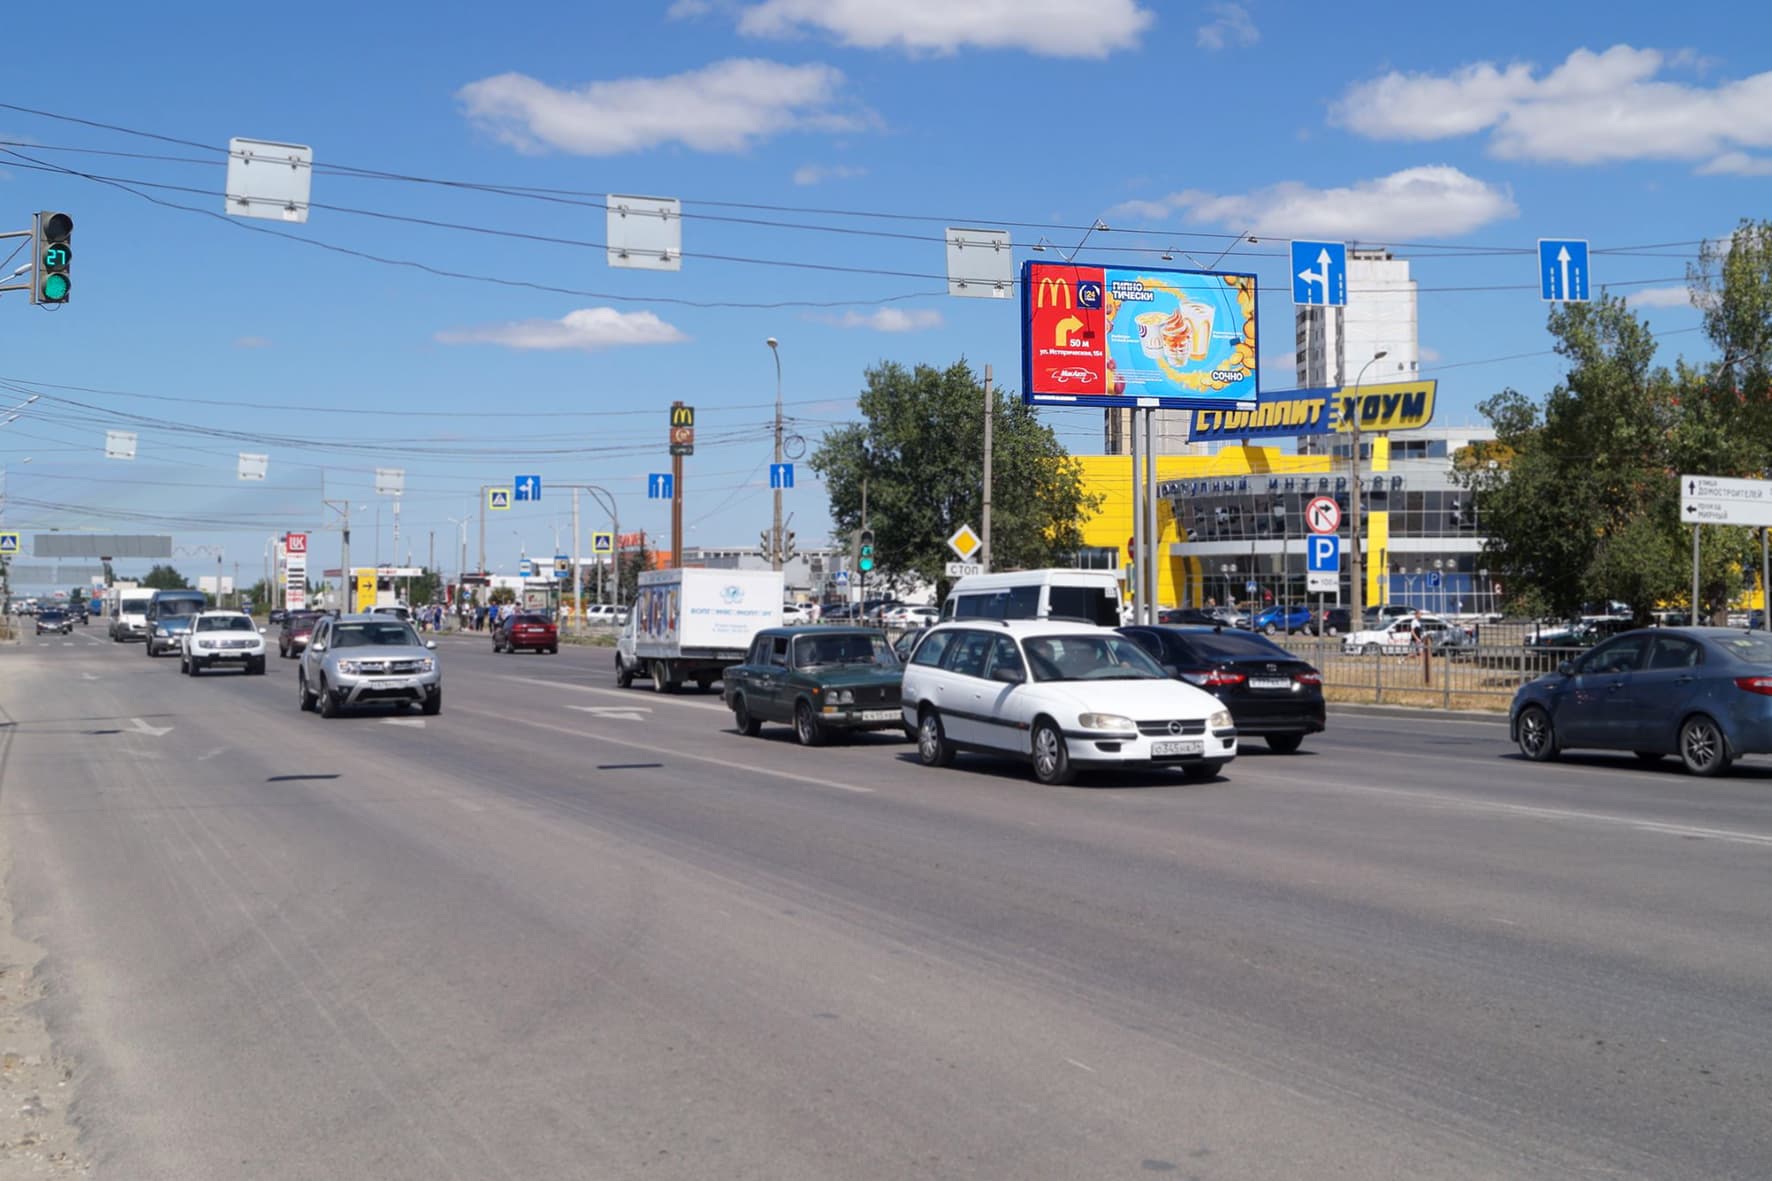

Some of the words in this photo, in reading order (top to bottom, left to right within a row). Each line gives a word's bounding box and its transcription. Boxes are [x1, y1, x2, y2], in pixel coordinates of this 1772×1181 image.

[46, 249, 66, 265] 27
[1112, 281, 1143, 291] ГИПНО
[1112, 290, 1153, 300] ТИЧЕСКИ
[1070, 339, 1081, 348] 50
[1212, 371, 1243, 382] СОЧНО
[1343, 392, 1427, 421] ХОУМ
[1269, 475, 1402, 491] интерер
[950, 565, 978, 576] СТОП
